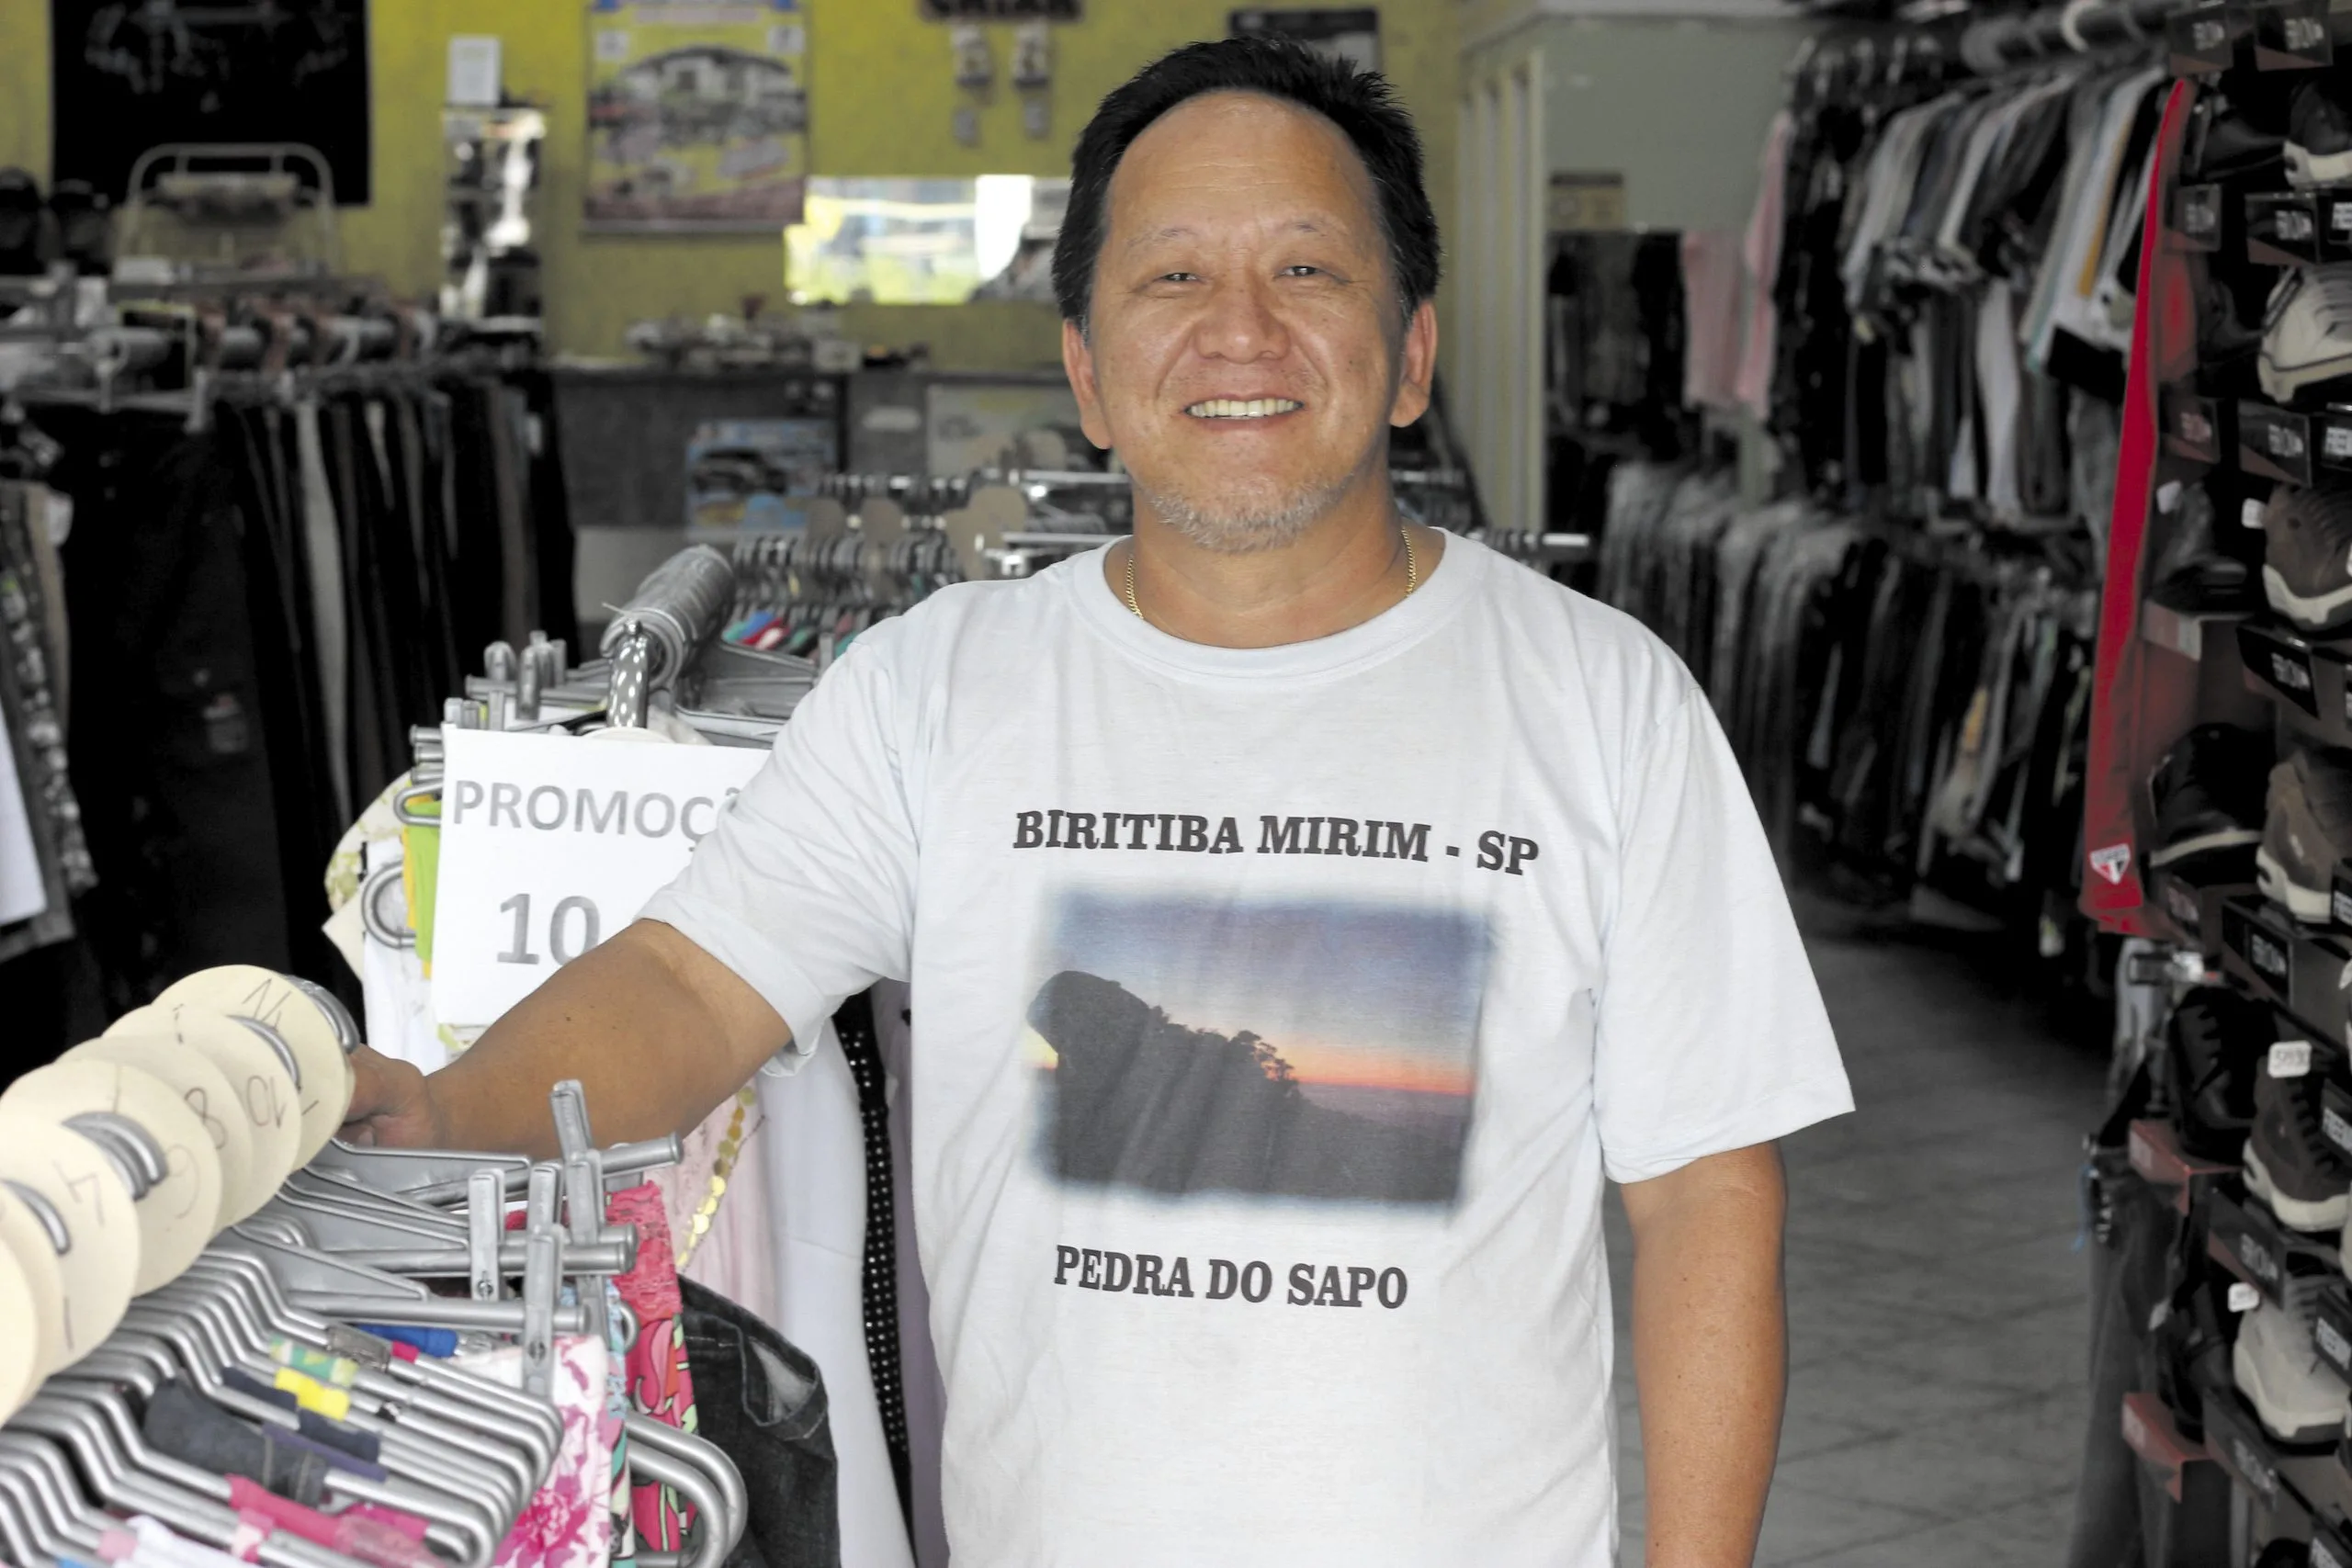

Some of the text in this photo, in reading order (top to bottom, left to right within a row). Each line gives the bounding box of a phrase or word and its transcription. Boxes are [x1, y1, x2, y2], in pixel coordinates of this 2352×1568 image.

[451, 779, 741, 852] PROMOÇ
[1012, 809, 1244, 854] BIRITIBA
[1257, 816, 1431, 863] MIRIM
[1476, 829, 1540, 875] SP
[496, 892, 602, 967] 10
[1054, 1245, 1408, 1310] PEDRA DO SAPO
